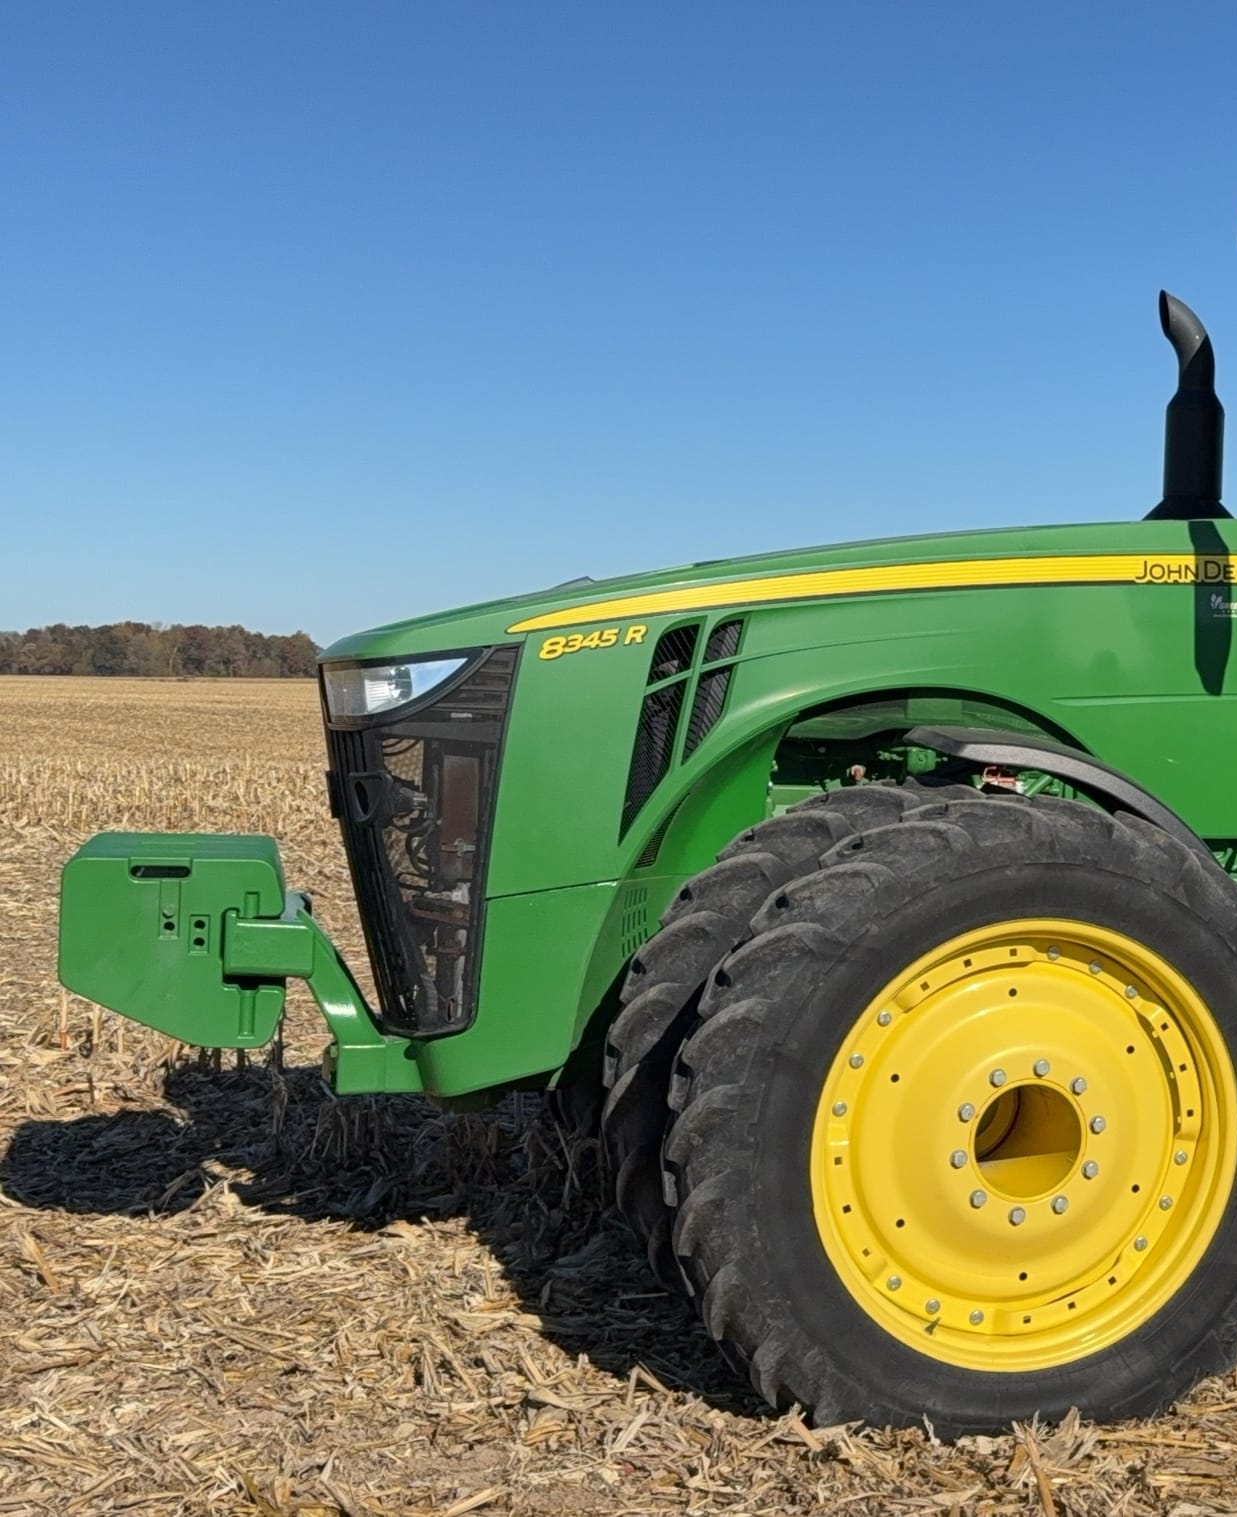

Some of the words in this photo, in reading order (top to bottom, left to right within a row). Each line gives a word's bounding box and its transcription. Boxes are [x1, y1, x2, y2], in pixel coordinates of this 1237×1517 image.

[1135, 560, 1199, 581] JOHN
[538, 628, 621, 660] 8345
[623, 625, 648, 645] R
